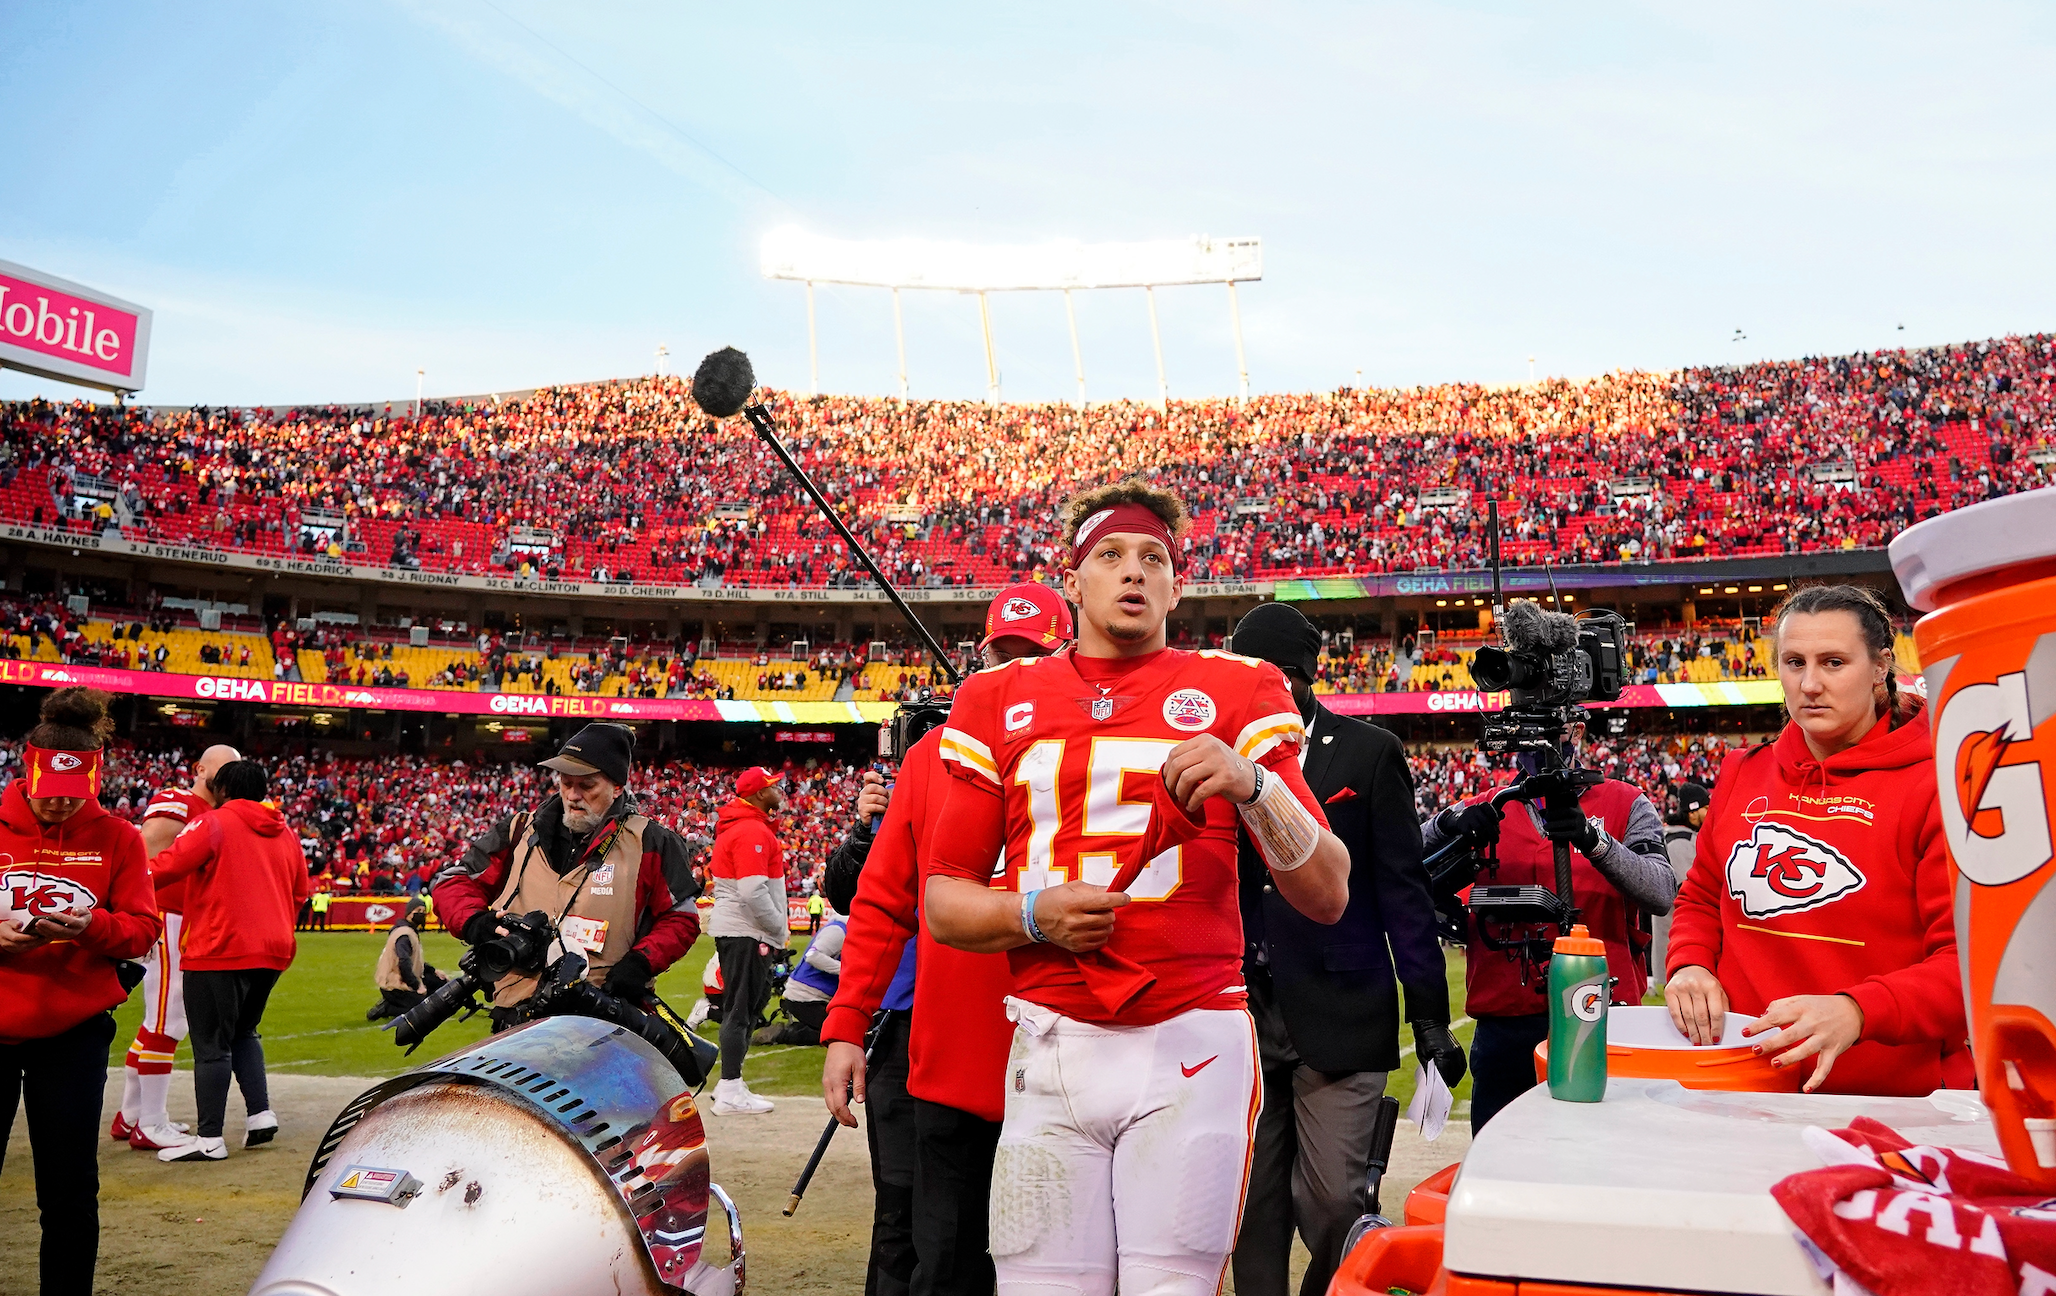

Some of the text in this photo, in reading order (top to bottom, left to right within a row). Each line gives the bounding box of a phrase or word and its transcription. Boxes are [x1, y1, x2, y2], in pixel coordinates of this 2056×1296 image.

[43, 530, 100, 548] HAYNES
[156, 547, 228, 563] STENERUD
[287, 561, 354, 576] HEADRICK
[410, 573, 460, 586] RUDNAY
[485, 579, 498, 588] 32
[1396, 576, 1450, 593] GEHA
[1453, 575, 1504, 591] FIEL
[632, 587, 678, 596] CHERRY
[702, 590, 713, 598] 73
[727, 590, 751, 599] HILL
[800, 590, 830, 600] STILL
[853, 592, 864, 600] 34
[952, 591, 965, 599] 35
[1010, 602, 1031, 616] KC
[0, 661, 36, 682] LD
[195, 676, 340, 705] GEHA FIELD
[489, 695, 606, 716] GEHA FIELD
[1428, 691, 1512, 712] GEHA FIE
[1005, 702, 1034, 731] C
[1788, 793, 1876, 810] KANSAS CITY
[1013, 736, 1184, 903] 15
[1827, 805, 1875, 820] CHIEFS
[595, 872, 611, 882] NFL
[1750, 843, 1827, 899] KC
[590, 886, 614, 896] MEDIA
[11, 884, 74, 918] KC
[1571, 983, 1603, 1023] G
